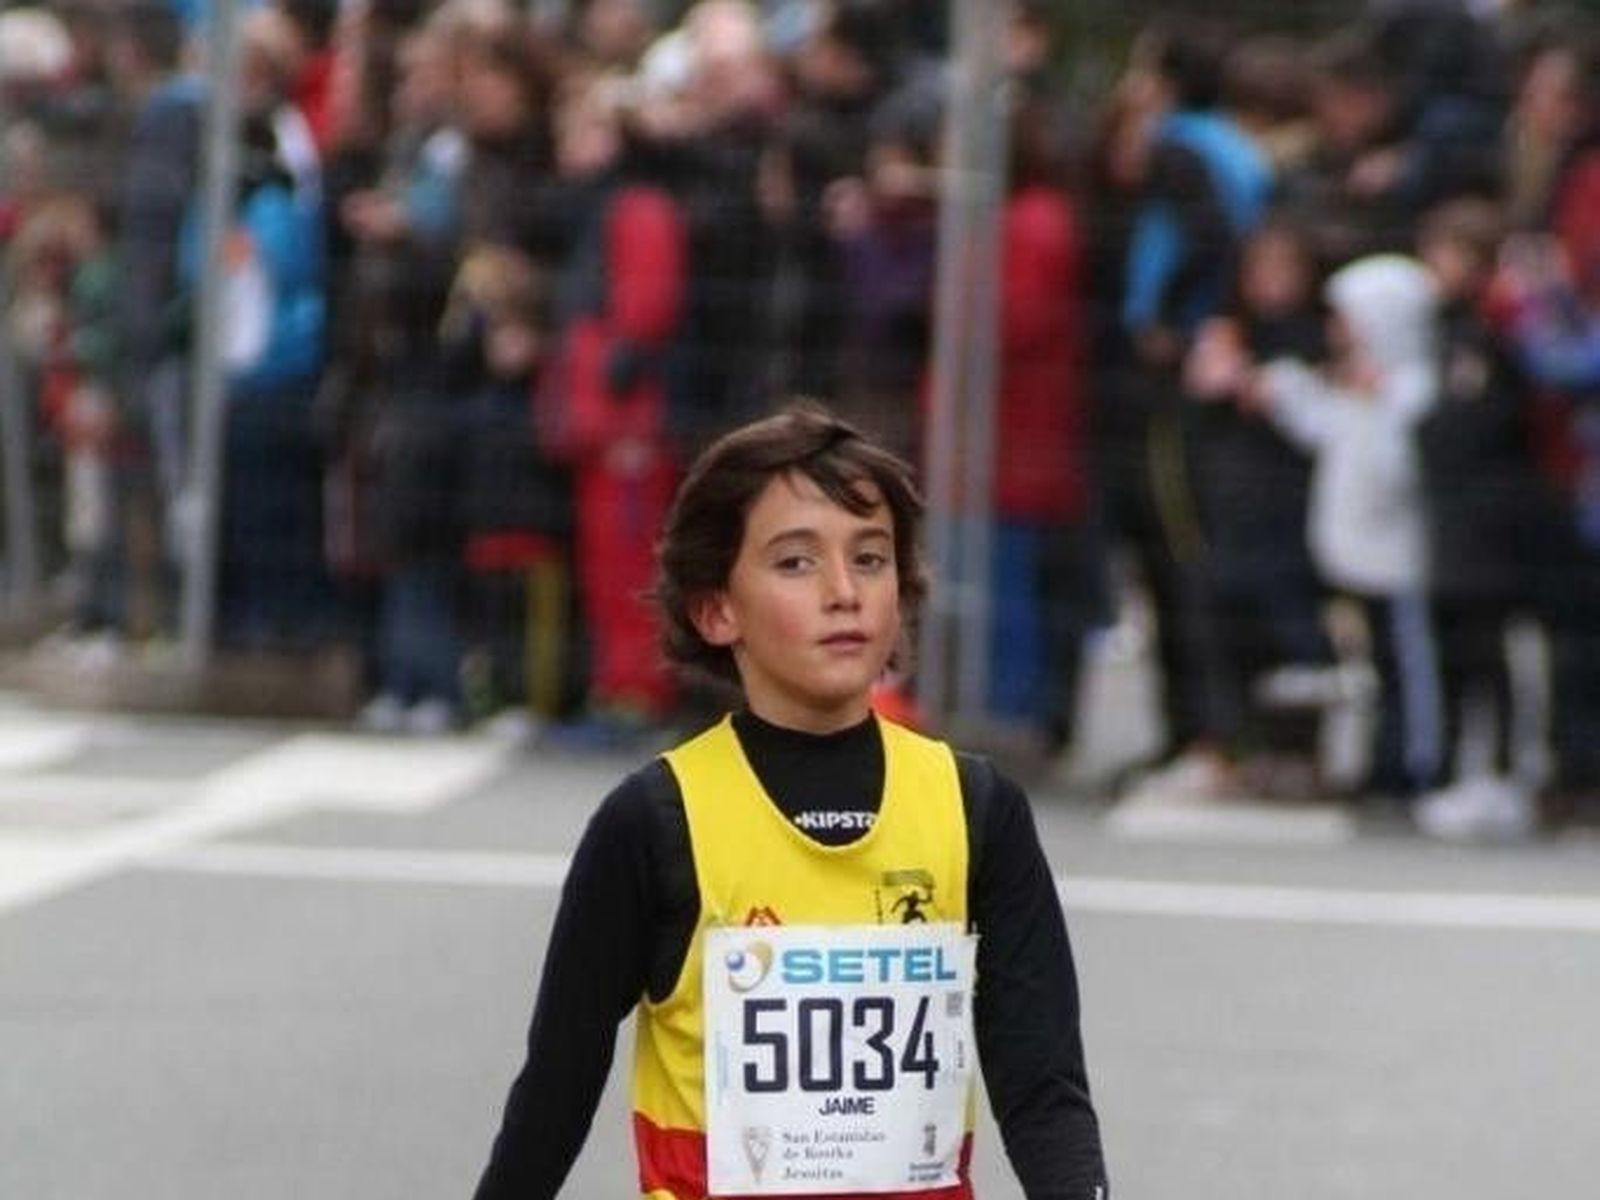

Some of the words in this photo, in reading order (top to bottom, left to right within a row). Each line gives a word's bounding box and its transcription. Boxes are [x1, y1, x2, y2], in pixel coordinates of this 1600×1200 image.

[782, 947, 957, 983] SETEL
[743, 996, 939, 1092] 5034
[819, 1096, 875, 1116] JAIME
